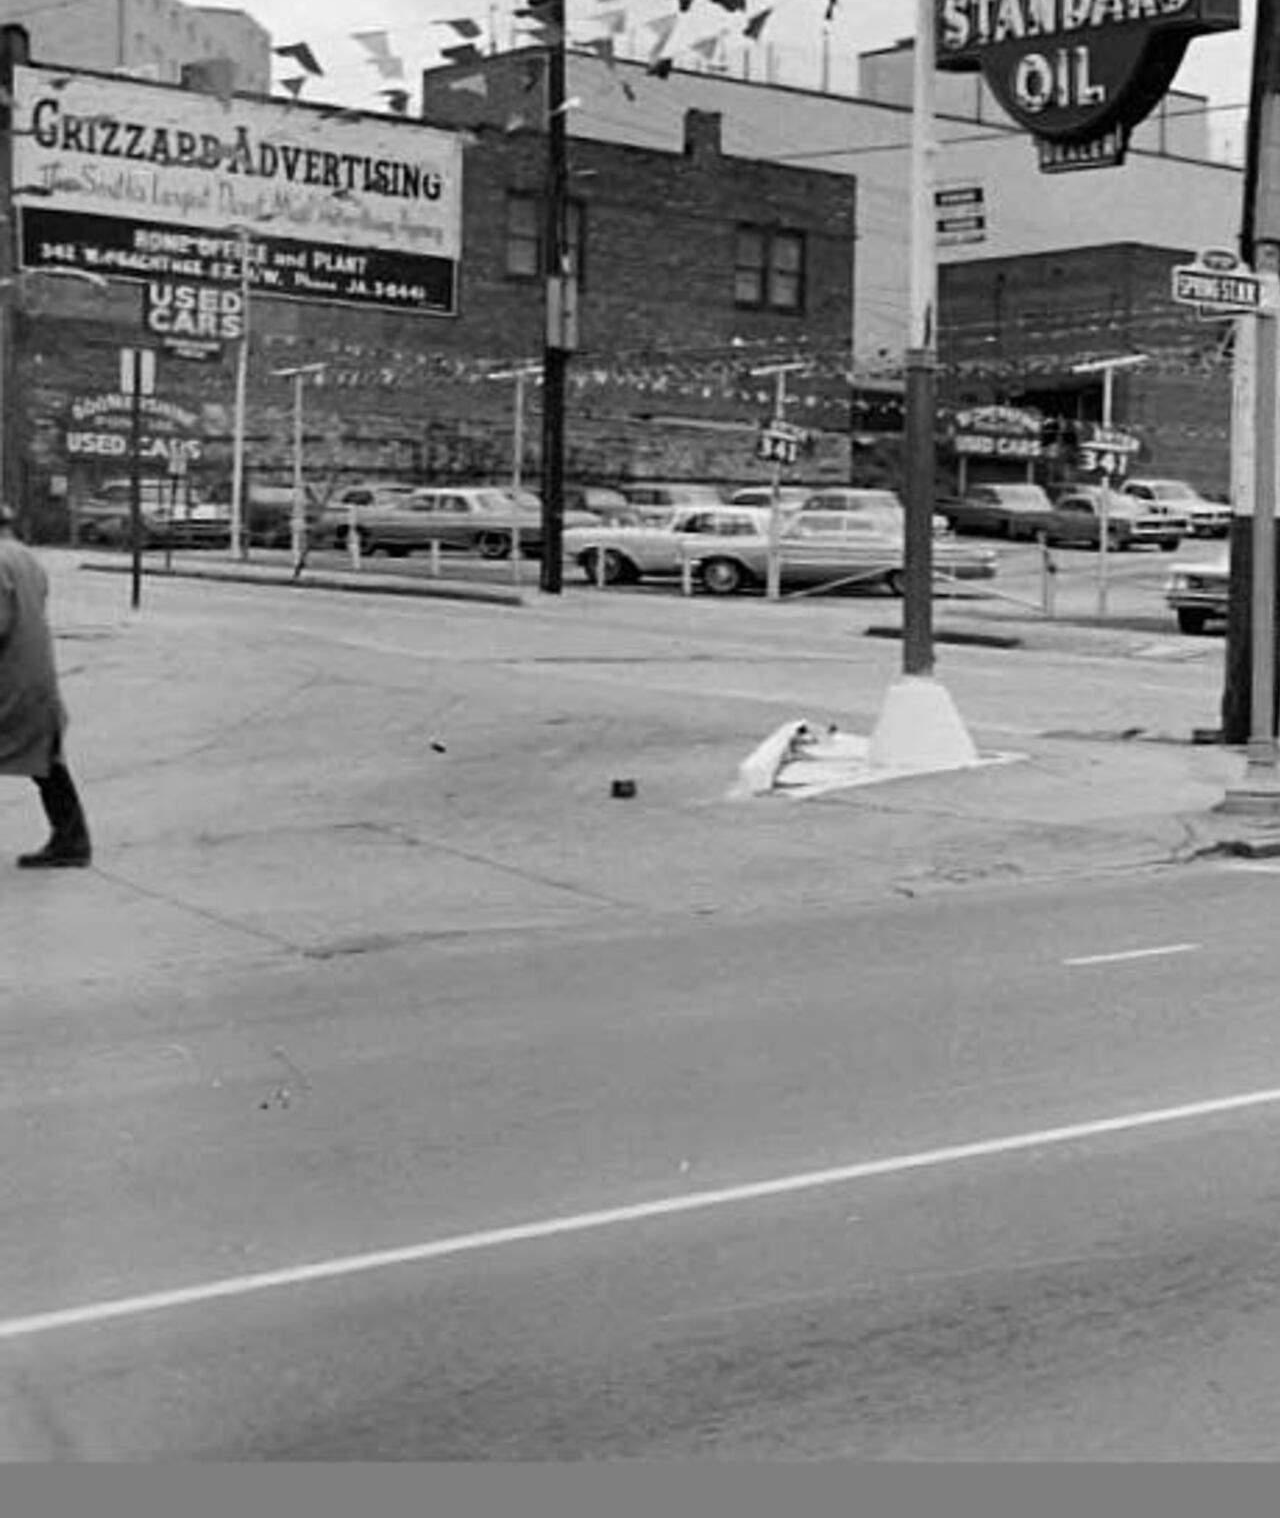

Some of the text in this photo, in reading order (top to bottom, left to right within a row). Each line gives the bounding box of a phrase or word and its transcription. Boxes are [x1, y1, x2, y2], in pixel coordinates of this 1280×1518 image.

[1015, 47, 1106, 113] OIL
[33, 98, 443, 201] GRIZZARD ADVERTISING
[150, 283, 241, 314] USED
[149, 308, 242, 339] CARS
[66, 432, 127, 454] USED
[1078, 450, 1127, 475] 341
